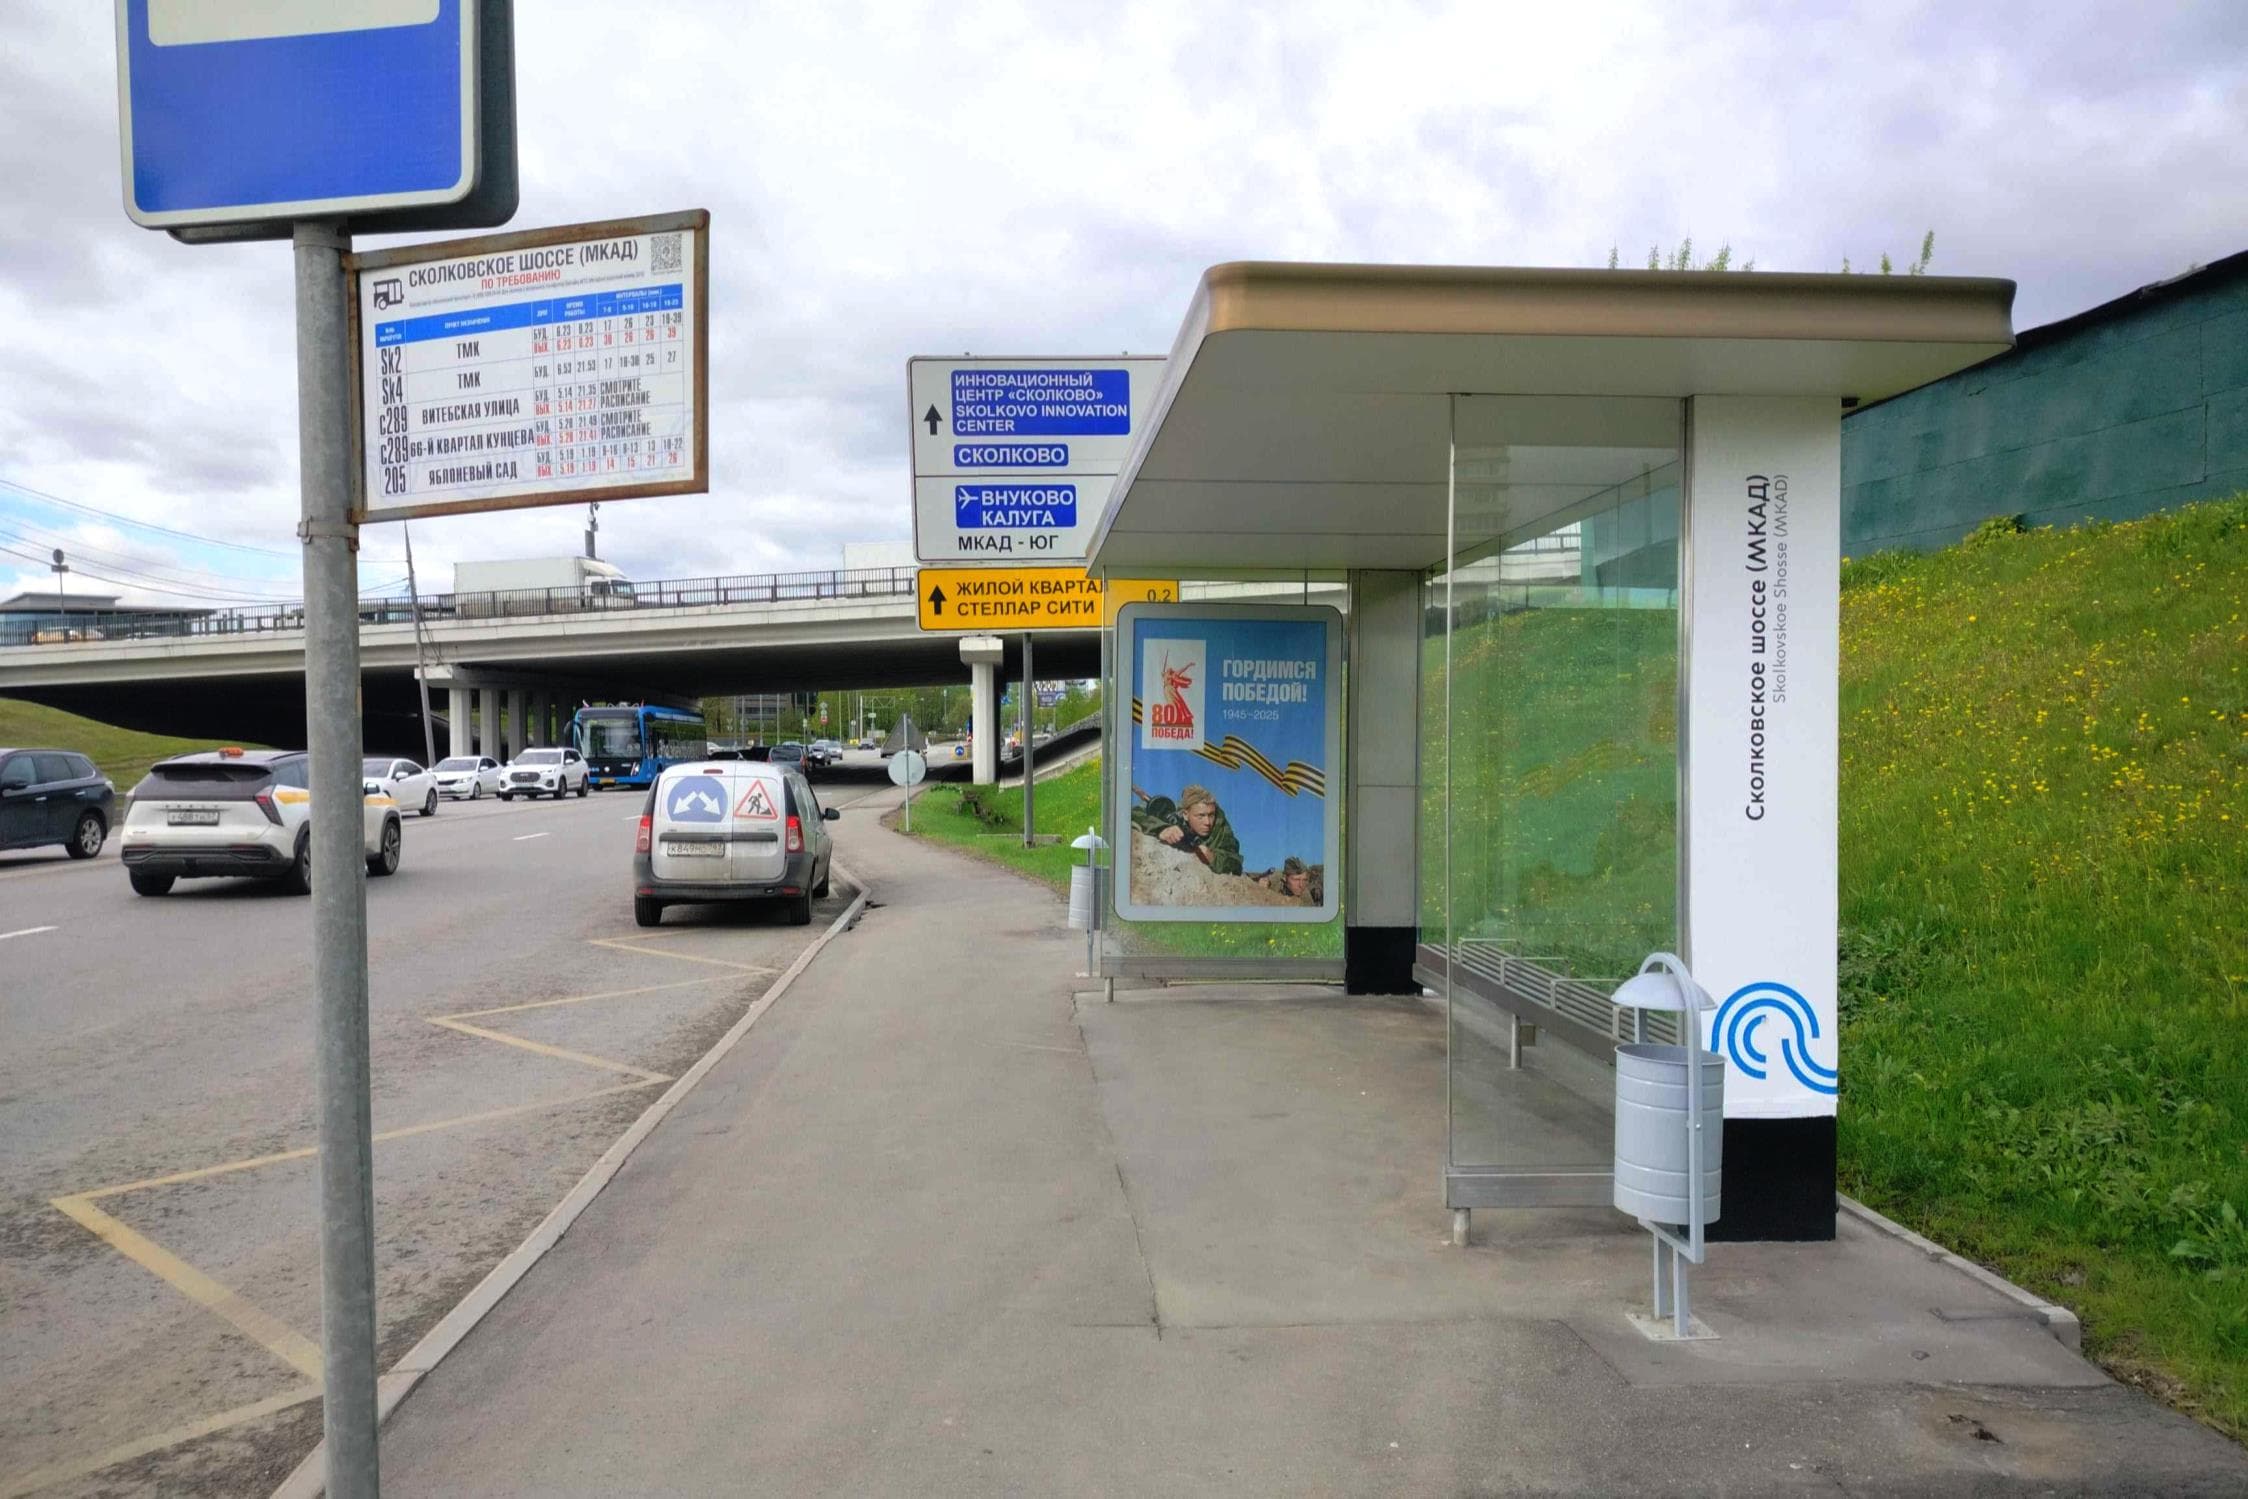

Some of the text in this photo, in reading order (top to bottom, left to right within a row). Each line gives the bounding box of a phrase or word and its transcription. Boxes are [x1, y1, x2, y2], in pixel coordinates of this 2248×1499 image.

[409, 256, 514, 287] СКОЛКОВСКОЕ
[520, 248, 574, 271] ШОССЕ
[580, 239, 638, 267] (МКАД)
[481, 278, 494, 290] ПО
[497, 269, 561, 288] ТРЕБОВАНИЮ
[604, 320, 612, 330] 17
[645, 315, 654, 326] 23
[456, 341, 480, 359] ТМК
[667, 351, 676, 362] 27
[381, 346, 402, 375] Sk2
[577, 360, 596, 373] 21.53
[604, 357, 612, 368] 17
[646, 354, 655, 365] 25
[457, 371, 481, 389] ТМК
[600, 378, 641, 394] СМОТРИТЕ
[955, 371, 1093, 389] ИННОВАЦИОННЫЙ
[382, 376, 403, 405] Sk4
[558, 387, 572, 399] 5.14
[578, 384, 596, 396] 21.35
[956, 388, 1103, 403] ЦЕНТР «СКОЛКОВО»
[558, 401, 573, 412] 5.14
[578, 399, 596, 411] 21.27
[600, 390, 650, 408] РАСПИСАНИЕ
[422, 398, 519, 425] ВИТЕБСКАЯ УЛИЦА
[601, 409, 641, 426] СМОТРИТЕ
[956, 404, 1127, 418] SKOLKOVO INNOVATION
[601, 422, 650, 440] РАСПИСАНИЕ
[956, 419, 1015, 432] CENTER
[410, 428, 535, 457] 66-Й КВАРТАЛ КУНЦЕВА
[579, 430, 597, 441] 21.41
[647, 440, 655, 451] 13
[627, 458, 636, 468] 15
[647, 455, 655, 466] 21
[958, 447, 1065, 464] СКОЛКОВО
[607, 459, 614, 470] 14
[385, 465, 406, 495] 205
[429, 461, 518, 486] ЯБЛОНЕВЫЙ САД
[981, 489, 1074, 506] ВНУКОВО
[982, 510, 1055, 526] КАЛУГА
[958, 535, 1012, 553] МКАД
[1030, 535, 1058, 550] ЮГ
[956, 579, 1024, 596] ЖИЛОЙ
[1773, 473, 1789, 704] Skolkovskoe Shosse (MKAD)
[957, 600, 1095, 616] СТЕЛЛАР СИТИ
[1745, 475, 1771, 821] Сколковское шоссе (МКАД)
[1222, 659, 1317, 681] ГОРДИМСЯ
[1222, 680, 1308, 705] ПОБЕДОЙ!
[1151, 703, 1177, 725] 80
[1151, 726, 1194, 740] ПОБЕДА!
